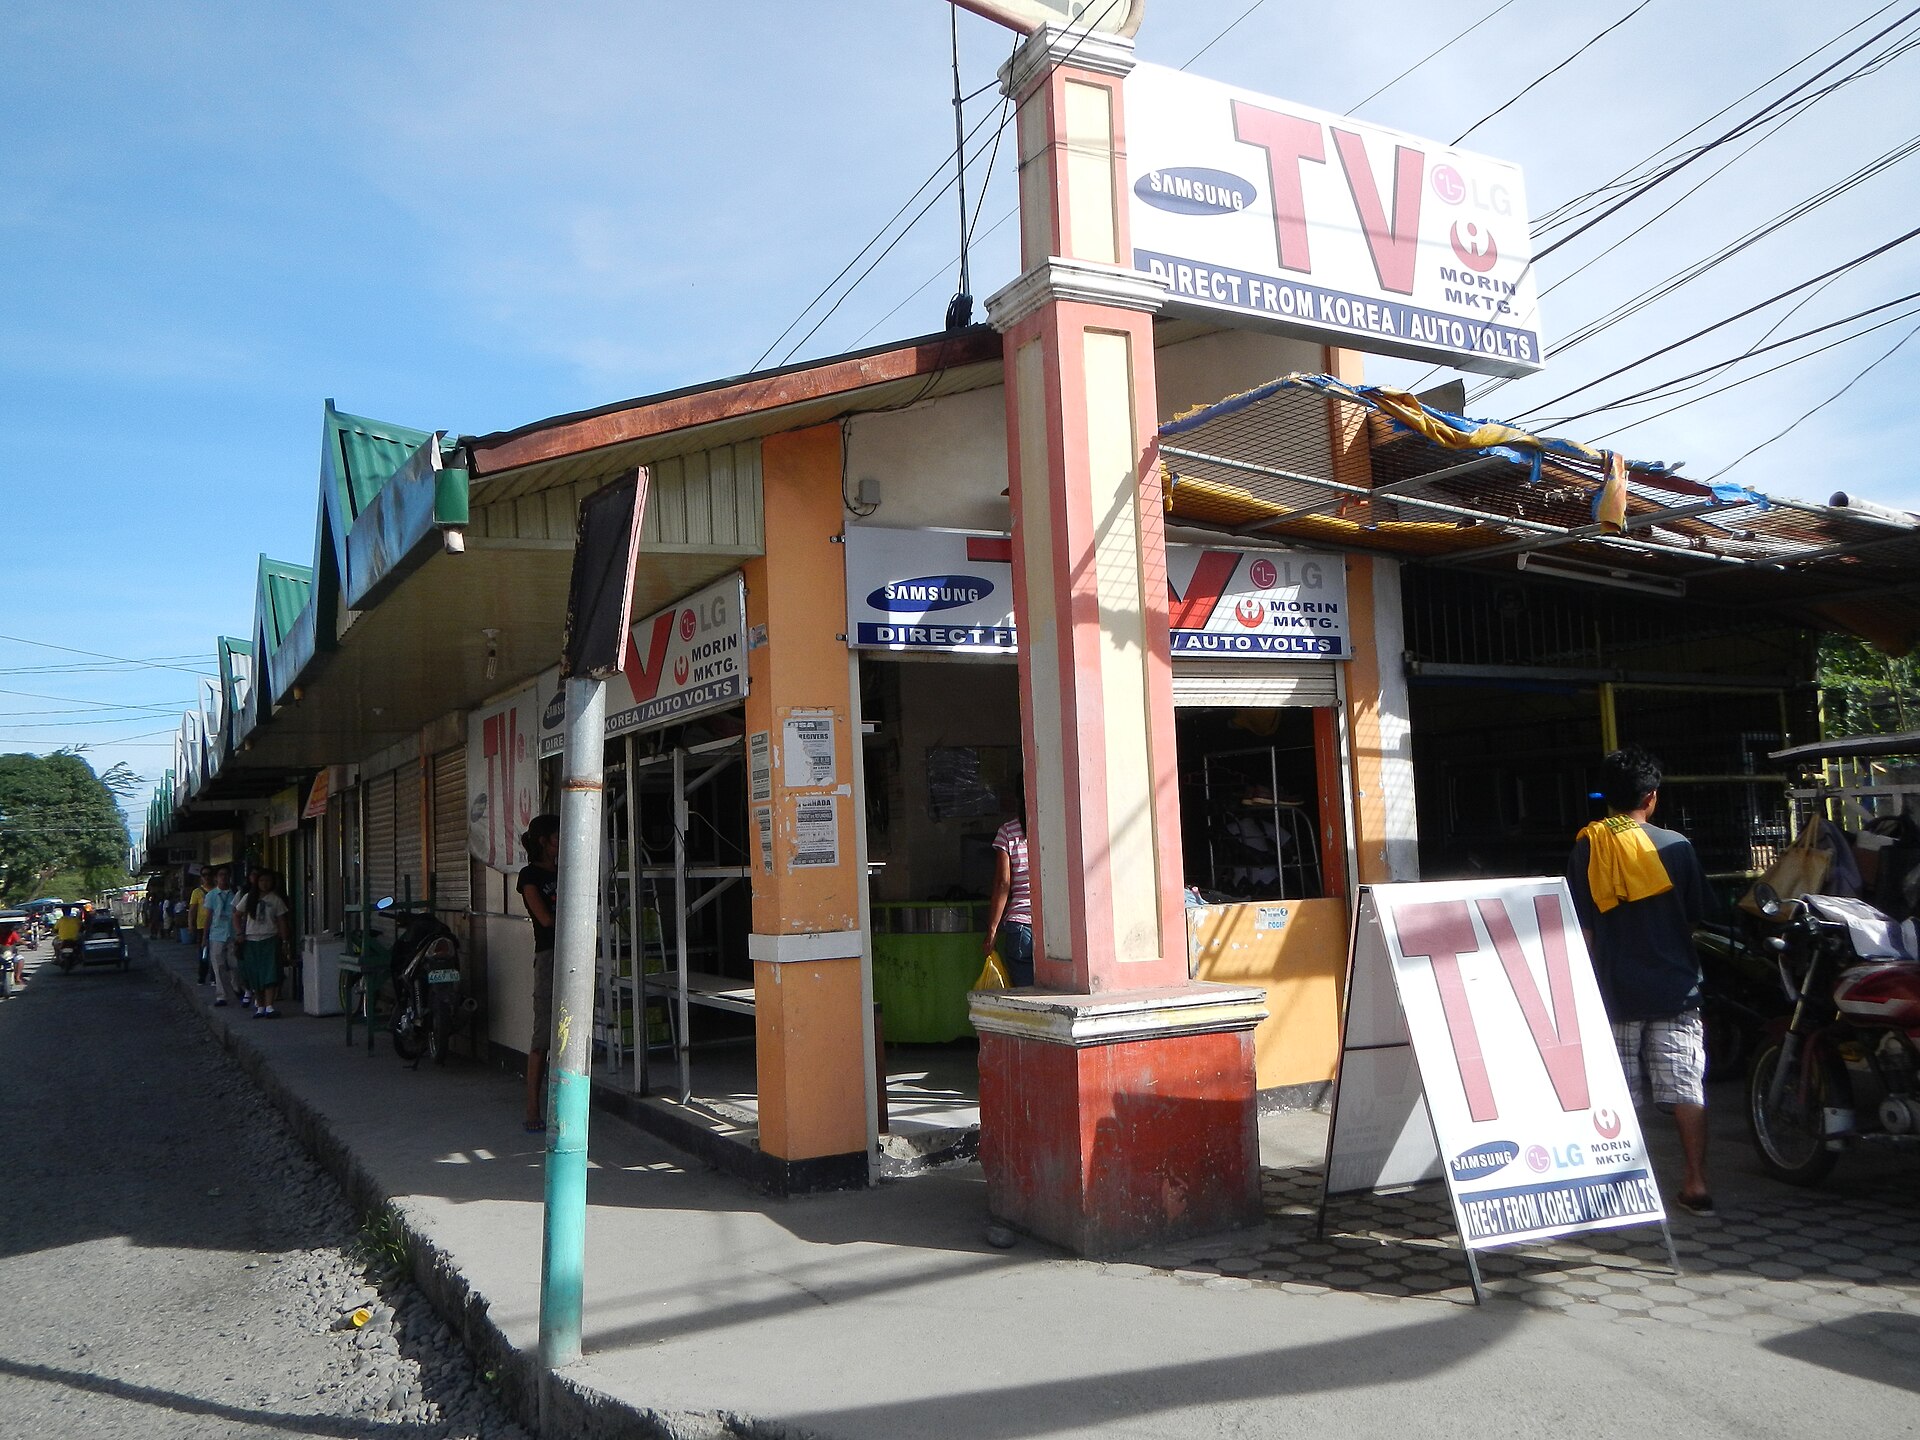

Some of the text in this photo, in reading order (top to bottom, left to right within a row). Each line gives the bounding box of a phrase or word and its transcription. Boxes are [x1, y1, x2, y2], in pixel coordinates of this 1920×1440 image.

[1150, 170, 1243, 211] SAMSUNG
[1230, 98, 1425, 296] TV
[1471, 178, 1512, 217] LG
[1440, 266, 1516, 296] MORIN
[1149, 259, 1242, 304] DIRECT
[1249, 280, 1314, 318] FROM
[1318, 293, 1396, 335] KOREA
[1410, 313, 1465, 347] AUTO
[1468, 324, 1532, 360] VOLTS
[1445, 287, 1519, 317] MKTG.
[1283, 561, 1323, 590] LG
[885, 584, 979, 602] SAMSUNG
[1270, 601, 1338, 614] MORIN
[700, 595, 726, 632] LG
[1274, 616, 1339, 629] MKTG.
[691, 633, 738, 662] MORIN
[876, 626, 985, 644] DIRECT
[1187, 635, 1251, 650] AUTO
[1257, 636, 1331, 652] VOLTS
[694, 657, 738, 682] MKTG.
[604, 710, 640, 731] KOREA
[648, 697, 682, 719] AUTO
[685, 681, 732, 706] VOLTS
[483, 707, 516, 866] TV
[1391, 893, 1591, 1122] TV
[1452, 1150, 1513, 1171] SAMSUNG
[1552, 1143, 1584, 1168] LG
[1591, 1140, 1631, 1153] MORIN
[1596, 1153, 1635, 1166] MKTG.
[1503, 1193, 1541, 1231] FROM
[1537, 1189, 1583, 1226] KOREA
[1586, 1183, 1620, 1219] AUTO
[1616, 1178, 1658, 1213] VOLTS
